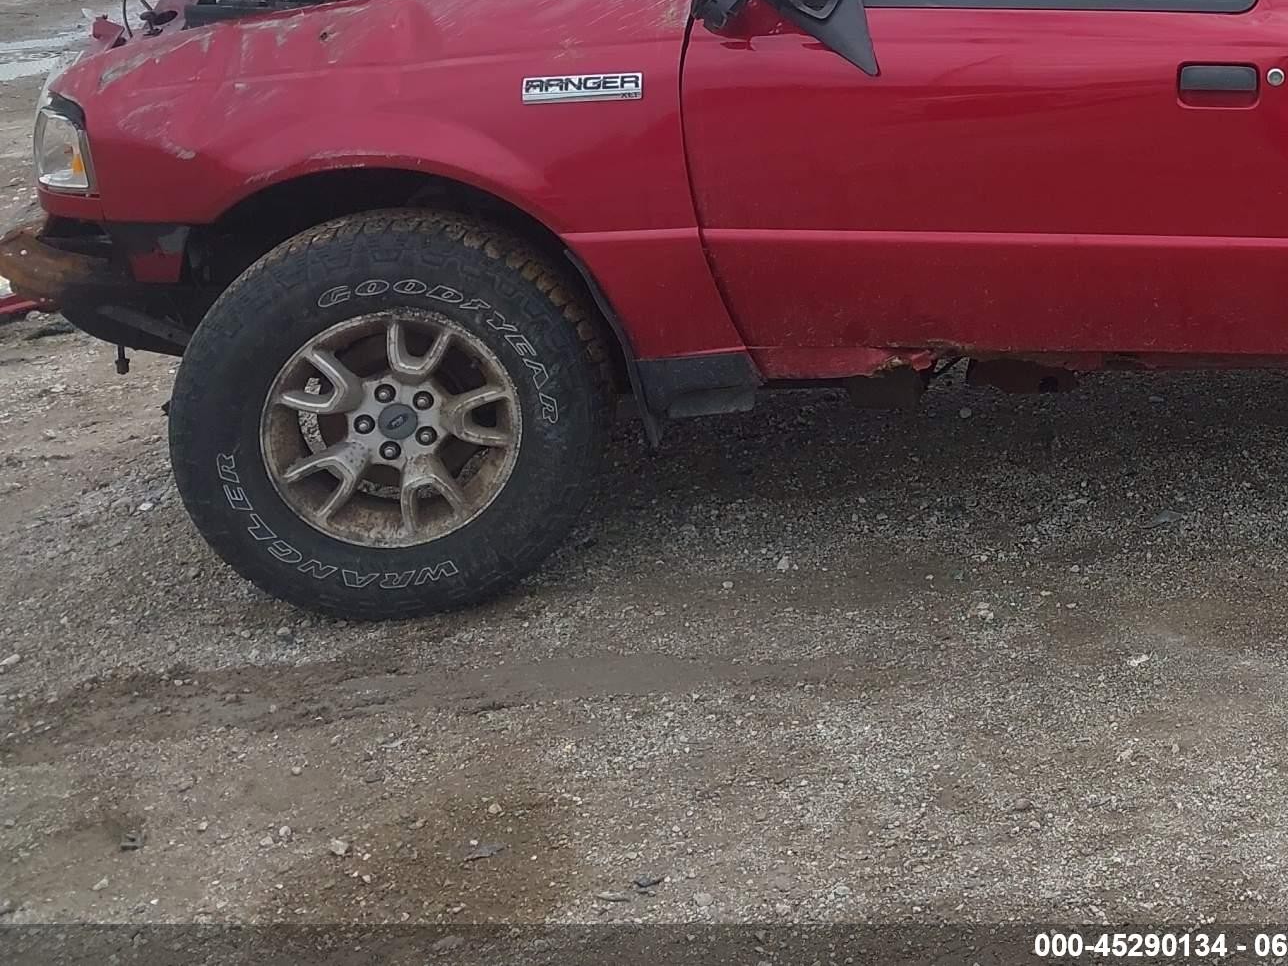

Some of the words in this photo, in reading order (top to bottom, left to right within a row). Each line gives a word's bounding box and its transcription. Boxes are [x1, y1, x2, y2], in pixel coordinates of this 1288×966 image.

[524, 75, 640, 93] RANGER
[317, 279, 559, 425] GOODYEAR
[216, 452, 459, 589] WRANGLER
